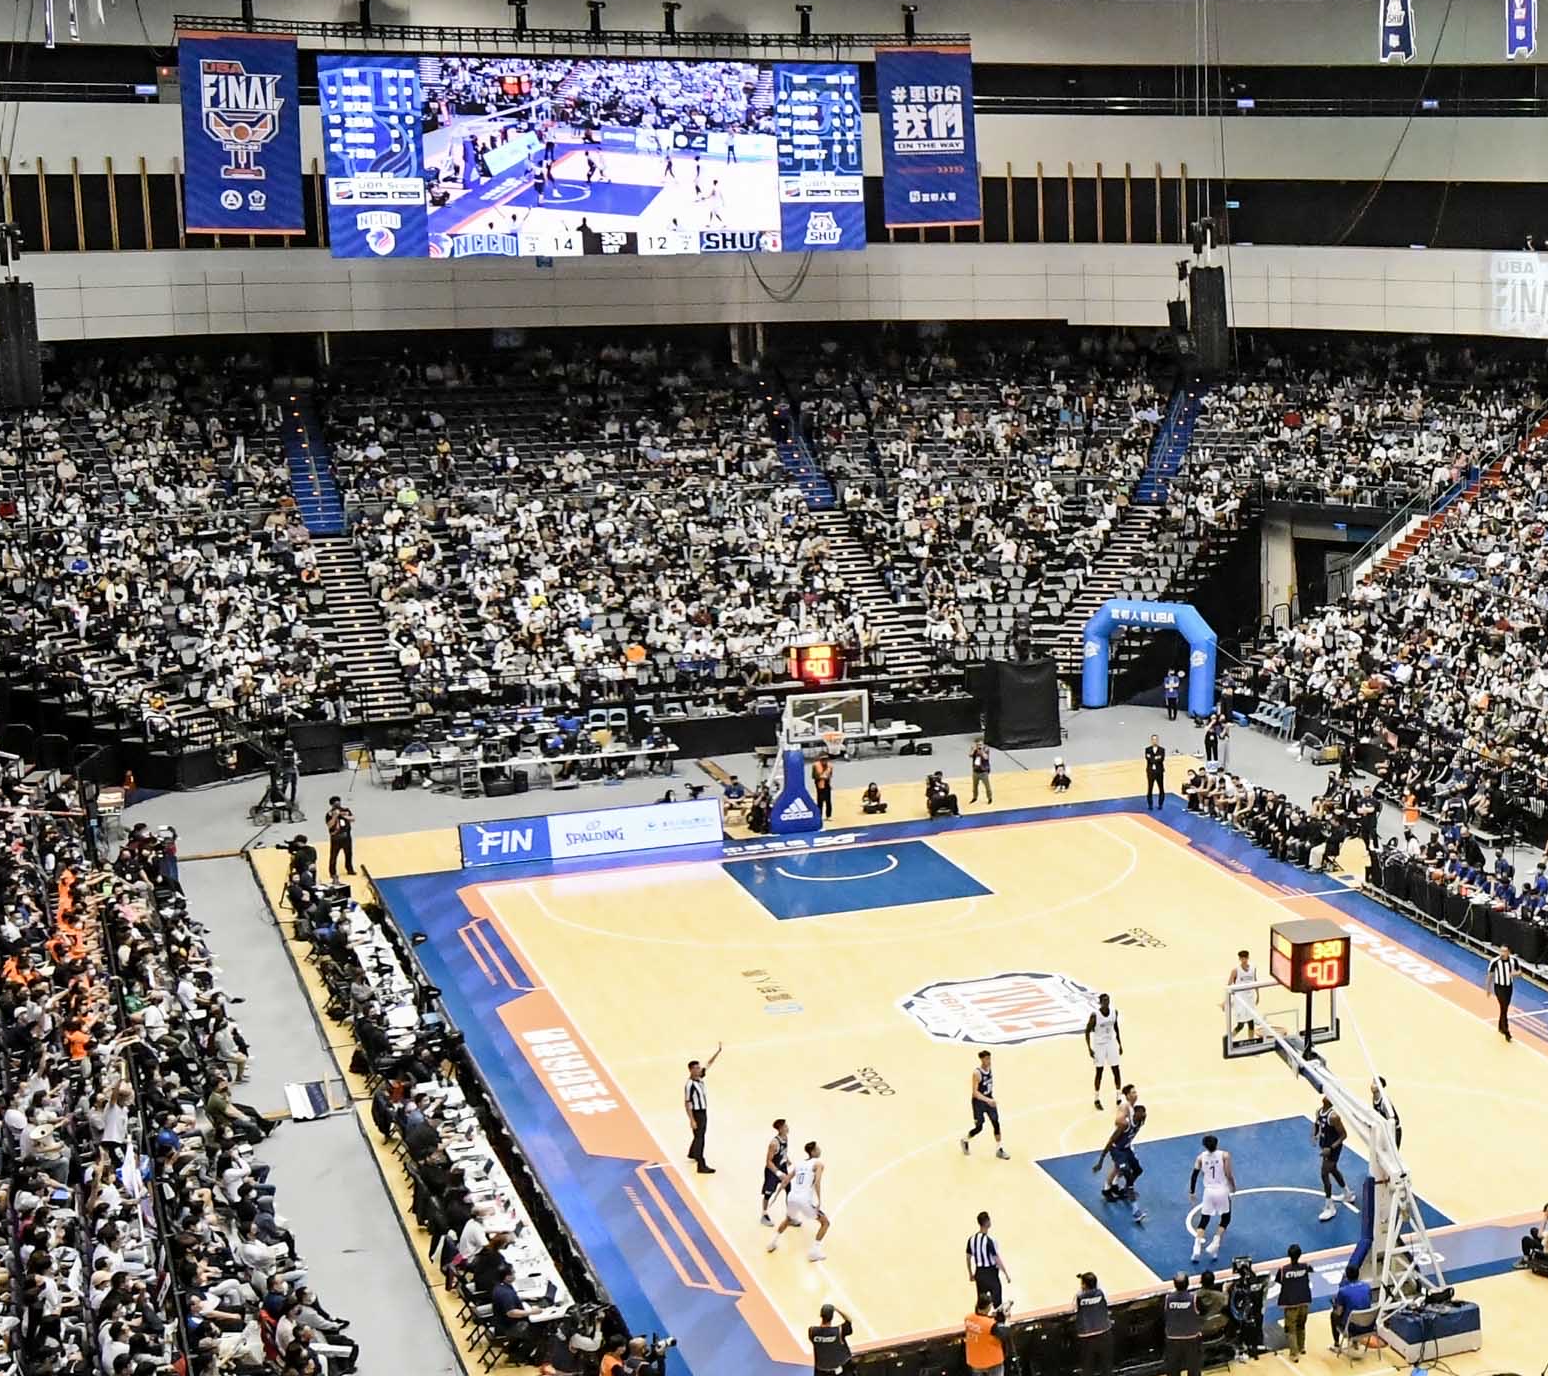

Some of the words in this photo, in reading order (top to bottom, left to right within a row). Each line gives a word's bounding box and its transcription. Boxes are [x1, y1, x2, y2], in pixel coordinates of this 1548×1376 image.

[203, 62, 244, 75] UBA
[203, 75, 283, 110] FINAL
[891, 85, 962, 103] #更好的
[893, 103, 964, 139] 我們
[452, 234, 517, 256] NCCU
[553, 238, 573, 250] 14
[648, 237, 667, 250] 12
[703, 232, 757, 252] SHU
[810, 230, 837, 241] SHU
[780, 811, 814, 823] adidas
[476, 824, 534, 856] FIN
[565, 826, 626, 847] SPALDING
